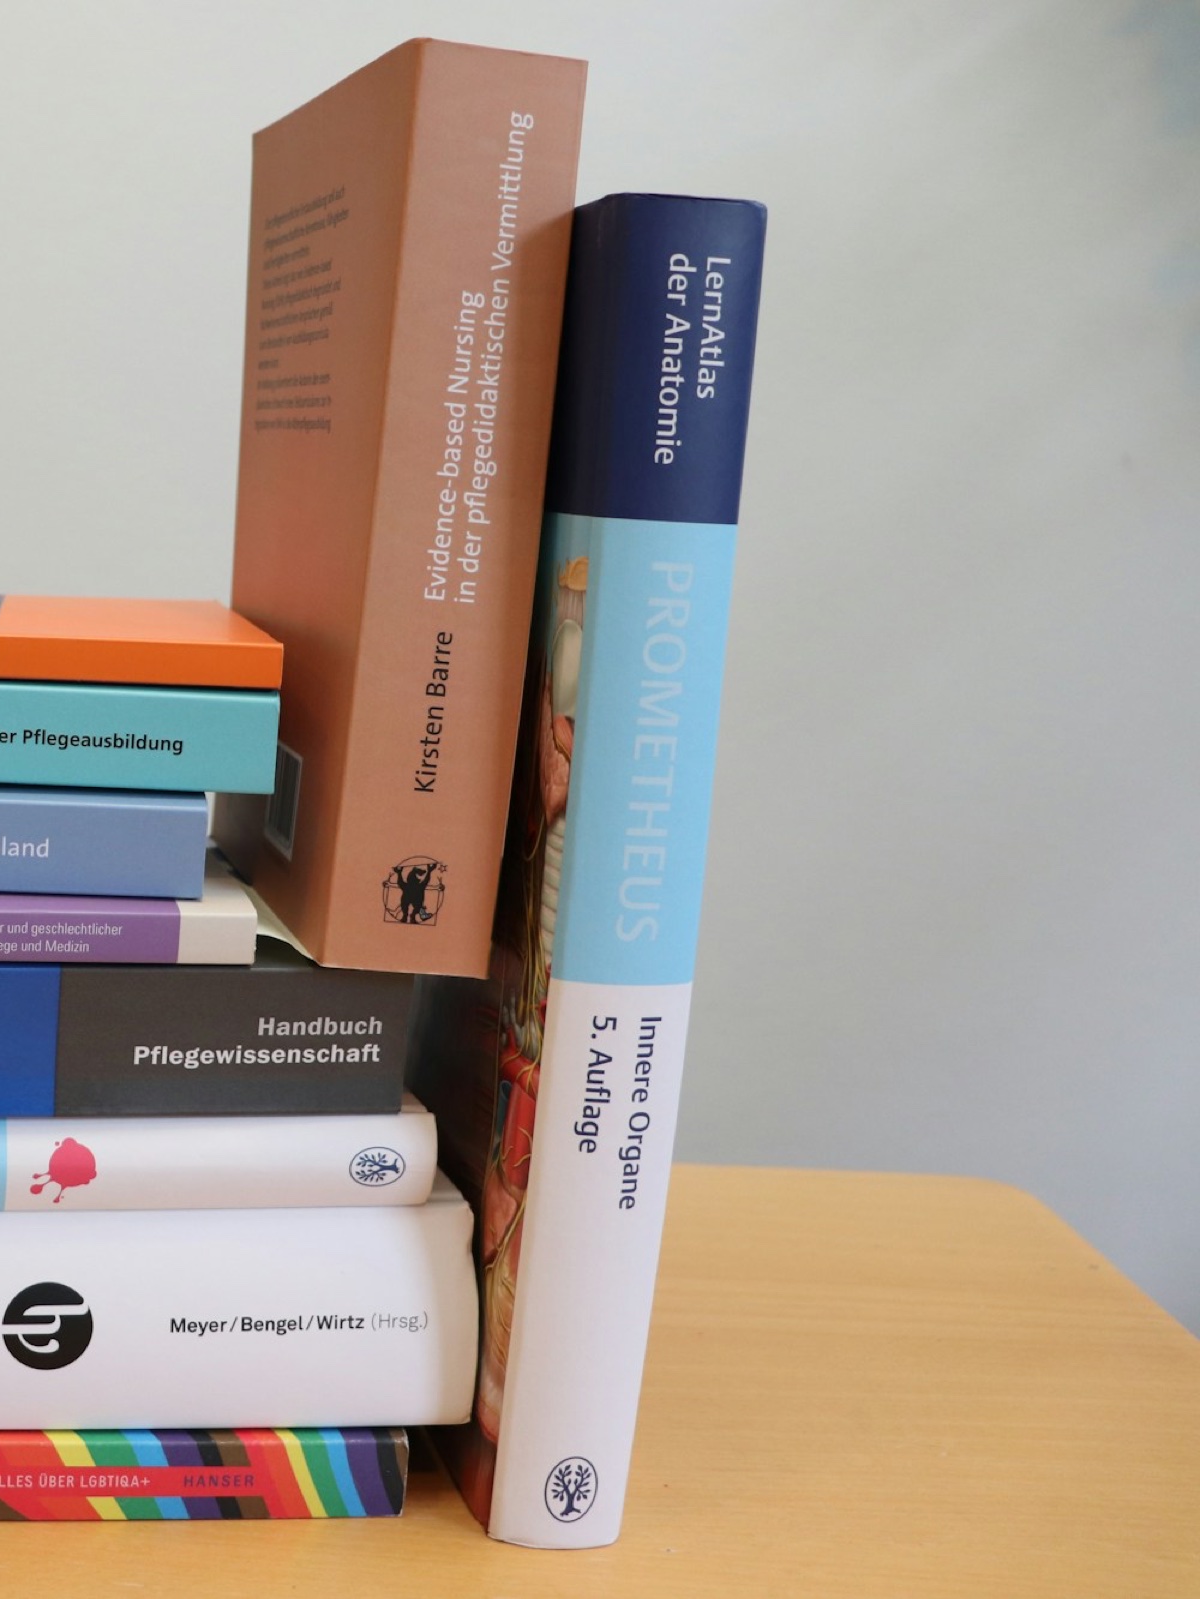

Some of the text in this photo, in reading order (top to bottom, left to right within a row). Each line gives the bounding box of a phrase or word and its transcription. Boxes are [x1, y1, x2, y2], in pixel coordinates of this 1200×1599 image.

[454, 112, 533, 603] in der pflegedidaktischen Vermittlung
[654, 252, 697, 465] der Anatomie
[697, 256, 732, 398] LernAtlas
[424, 291, 485, 601] Evidence-based Nursing
[22, 729, 184, 755] Pflegeausbildung
[414, 630, 453, 793] Kirsten Barre
[616, 560, 694, 942] PROMETHEUS
[7, 921, 28, 934] und
[31, 922, 122, 938] geschlechtlicher
[22, 939, 42, 952] und
[45, 940, 90, 954] Medizin
[133, 1045, 380, 1069] Pflegewissenschaft
[258, 1016, 383, 1036] Handbuch
[573, 1015, 617, 1155] 5. Auflage
[618, 1015, 662, 1210] Innere Organe
[371, 1311, 429, 1332] (Hrsg.)
[39, 1473, 74, 1488] ÜBER
[80, 1476, 150, 1488] LGBTIQA+
[183, 1474, 255, 1488] HANSER
